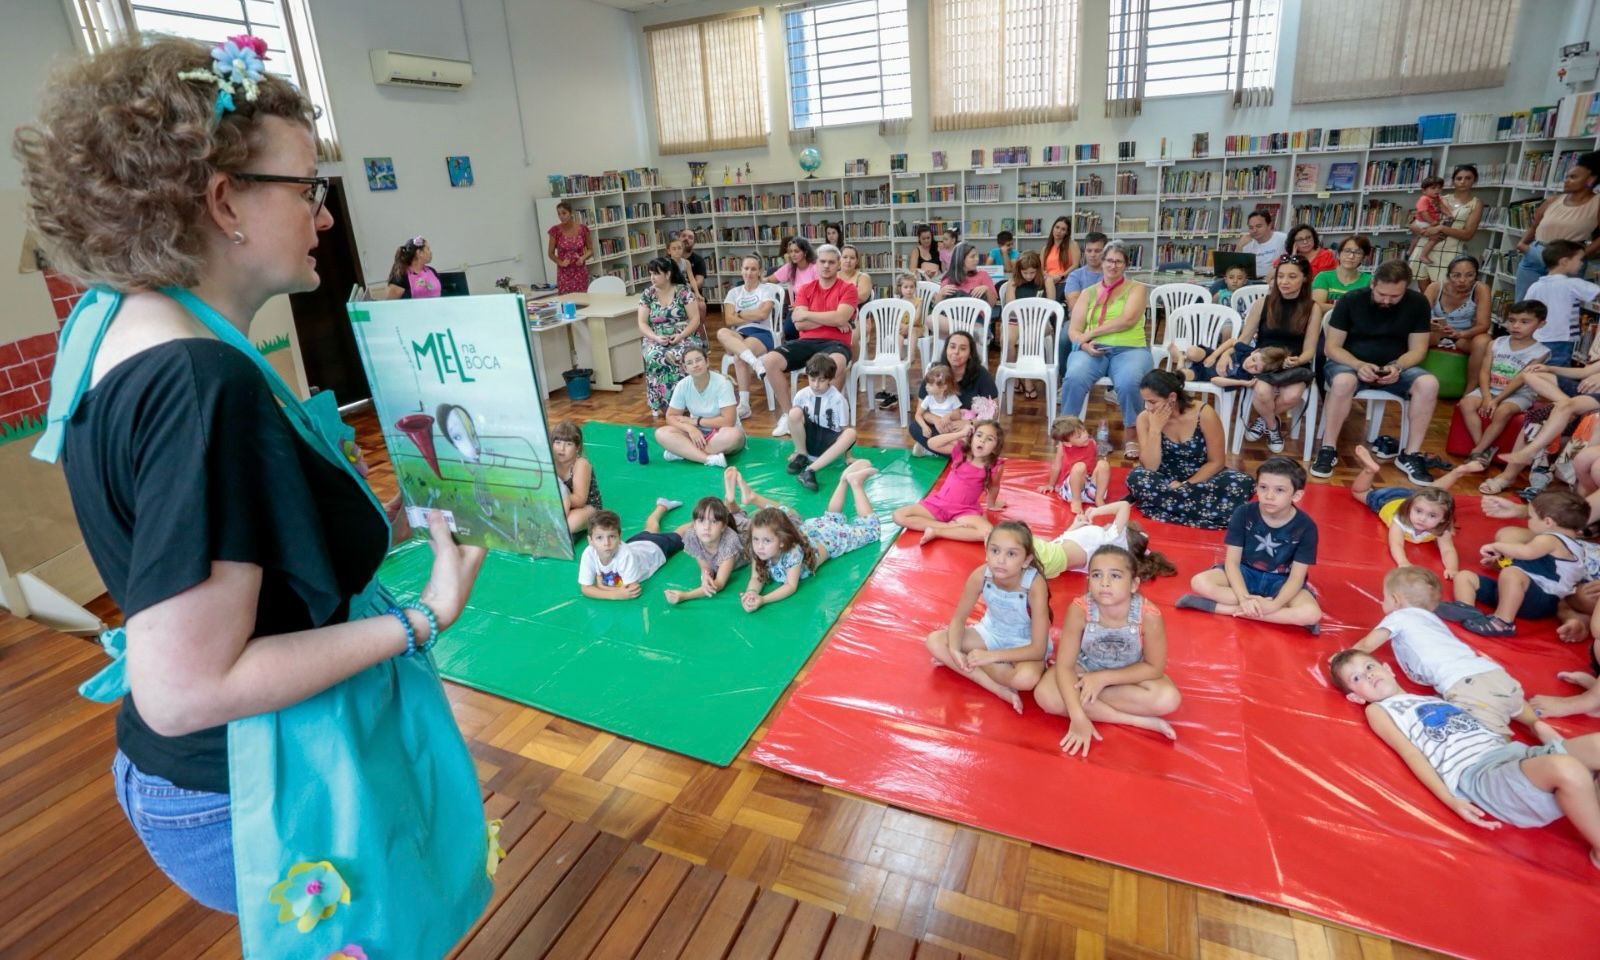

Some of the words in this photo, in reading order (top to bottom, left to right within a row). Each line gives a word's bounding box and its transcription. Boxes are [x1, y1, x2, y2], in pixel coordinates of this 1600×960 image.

[412, 328, 475, 384] MEL
[461, 343, 476, 353] na
[464, 355, 500, 369] BOCA
